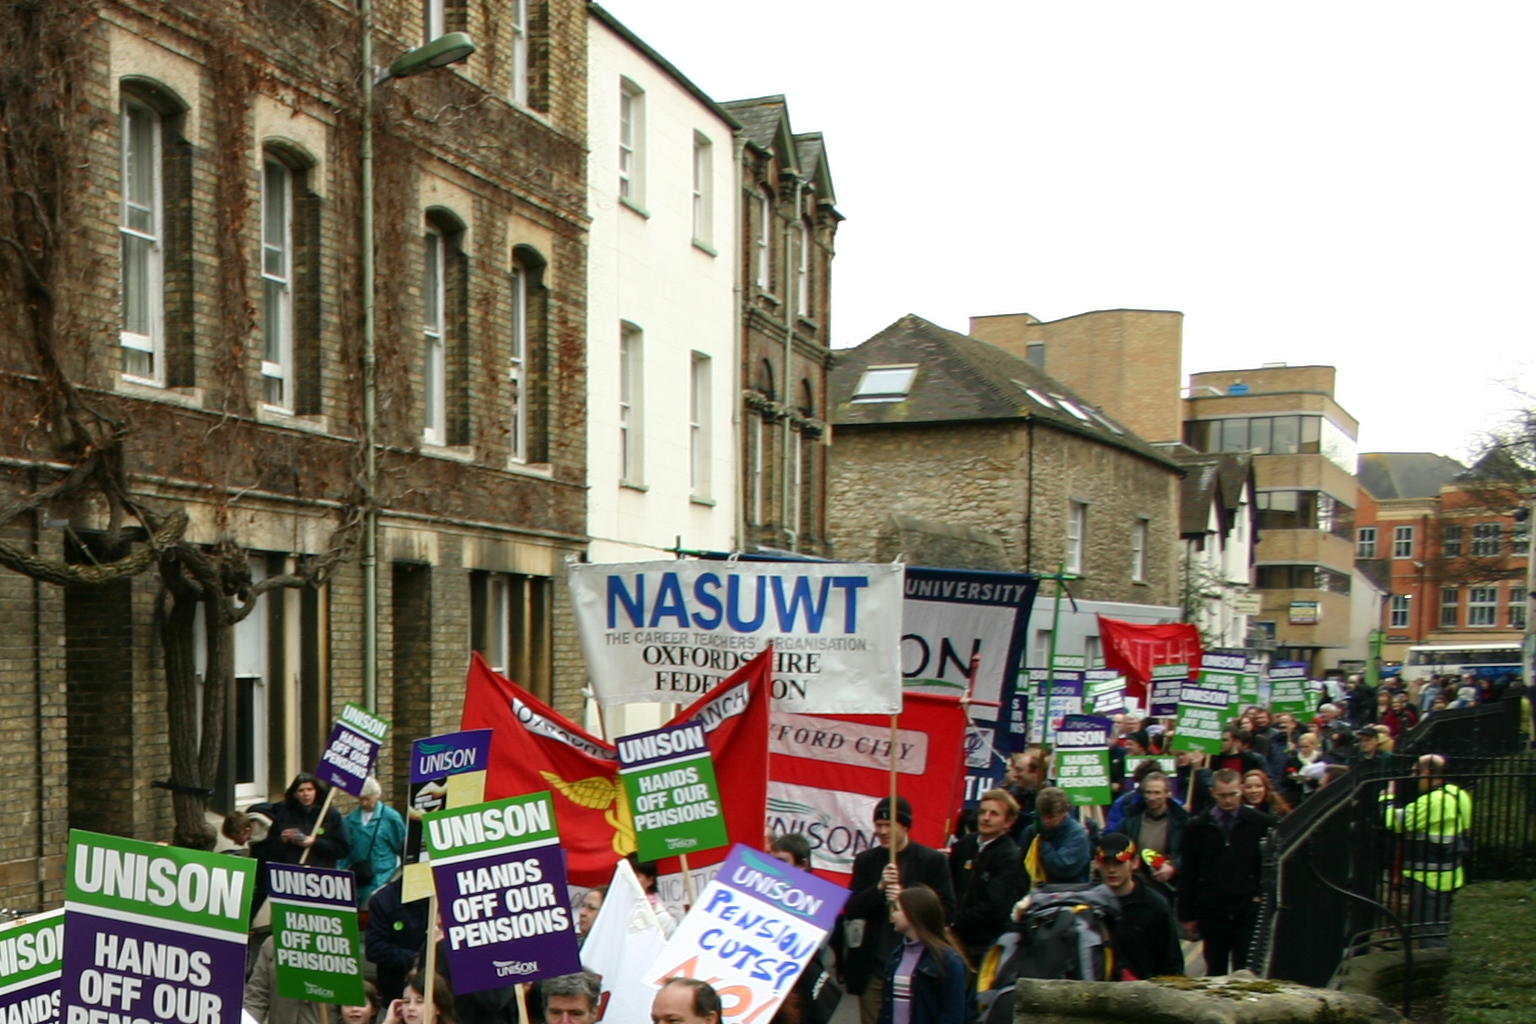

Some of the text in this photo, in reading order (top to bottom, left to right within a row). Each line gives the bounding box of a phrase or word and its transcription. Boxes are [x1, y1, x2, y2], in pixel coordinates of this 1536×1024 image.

[607, 572, 868, 634] NASUWT
[906, 578, 1028, 603] UNIVERSITY
[605, 633, 630, 645] THE
[634, 632, 688, 645] CAREER
[642, 644, 821, 673] OXFORDSIRE
[342, 704, 387, 738] UNISON
[618, 725, 705, 765] UNISON
[1057, 730, 1105, 746] UNISON
[420, 747, 477, 776] UNISON
[638, 767, 700, 794] HANDS
[636, 784, 710, 812] OFF OUR
[428, 800, 551, 851] UNISON
[634, 800, 719, 832] PENSIONS
[73, 843, 246, 920] UNISON
[269, 868, 352, 901] UNISON
[456, 858, 542, 896] HANDS
[731, 865, 824, 917] UNISON
[452, 893, 498, 923] OFF
[505, 883, 557, 914] OUR
[285, 912, 343, 936] HANDS
[449, 907, 570, 951] PENSIONS
[703, 888, 816, 960] PENSION
[280, 930, 351, 956] OFF OUR
[94, 932, 212, 988] HANDS
[278, 949, 359, 976] PENSIONS
[497, 961, 538, 978] UNISON
[79, 968, 142, 1011] OFF
